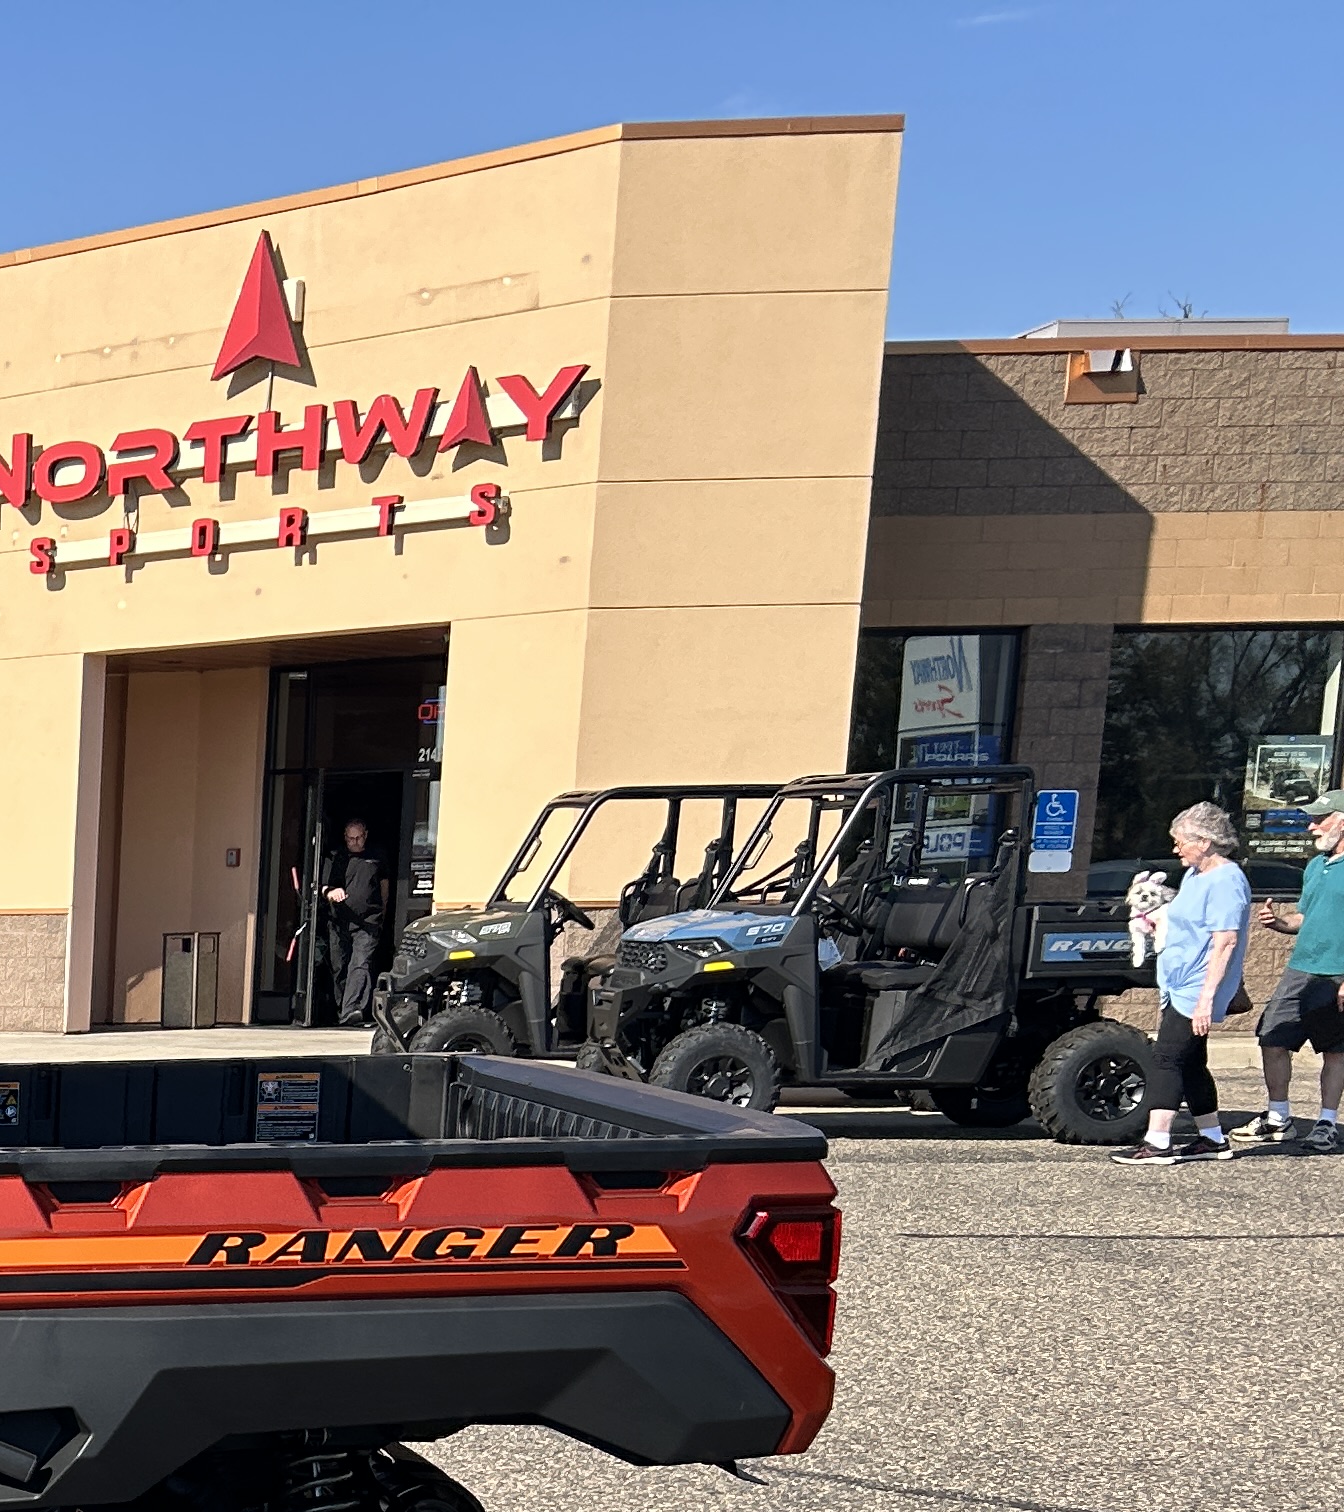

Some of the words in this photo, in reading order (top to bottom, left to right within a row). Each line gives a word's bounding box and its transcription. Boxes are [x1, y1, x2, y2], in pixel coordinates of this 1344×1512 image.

[29, 483, 501, 575] SPORTS
[418, 703, 445, 720] OP
[1049, 940, 1134, 952] RANG
[184, 1222, 636, 1268] RANGER
